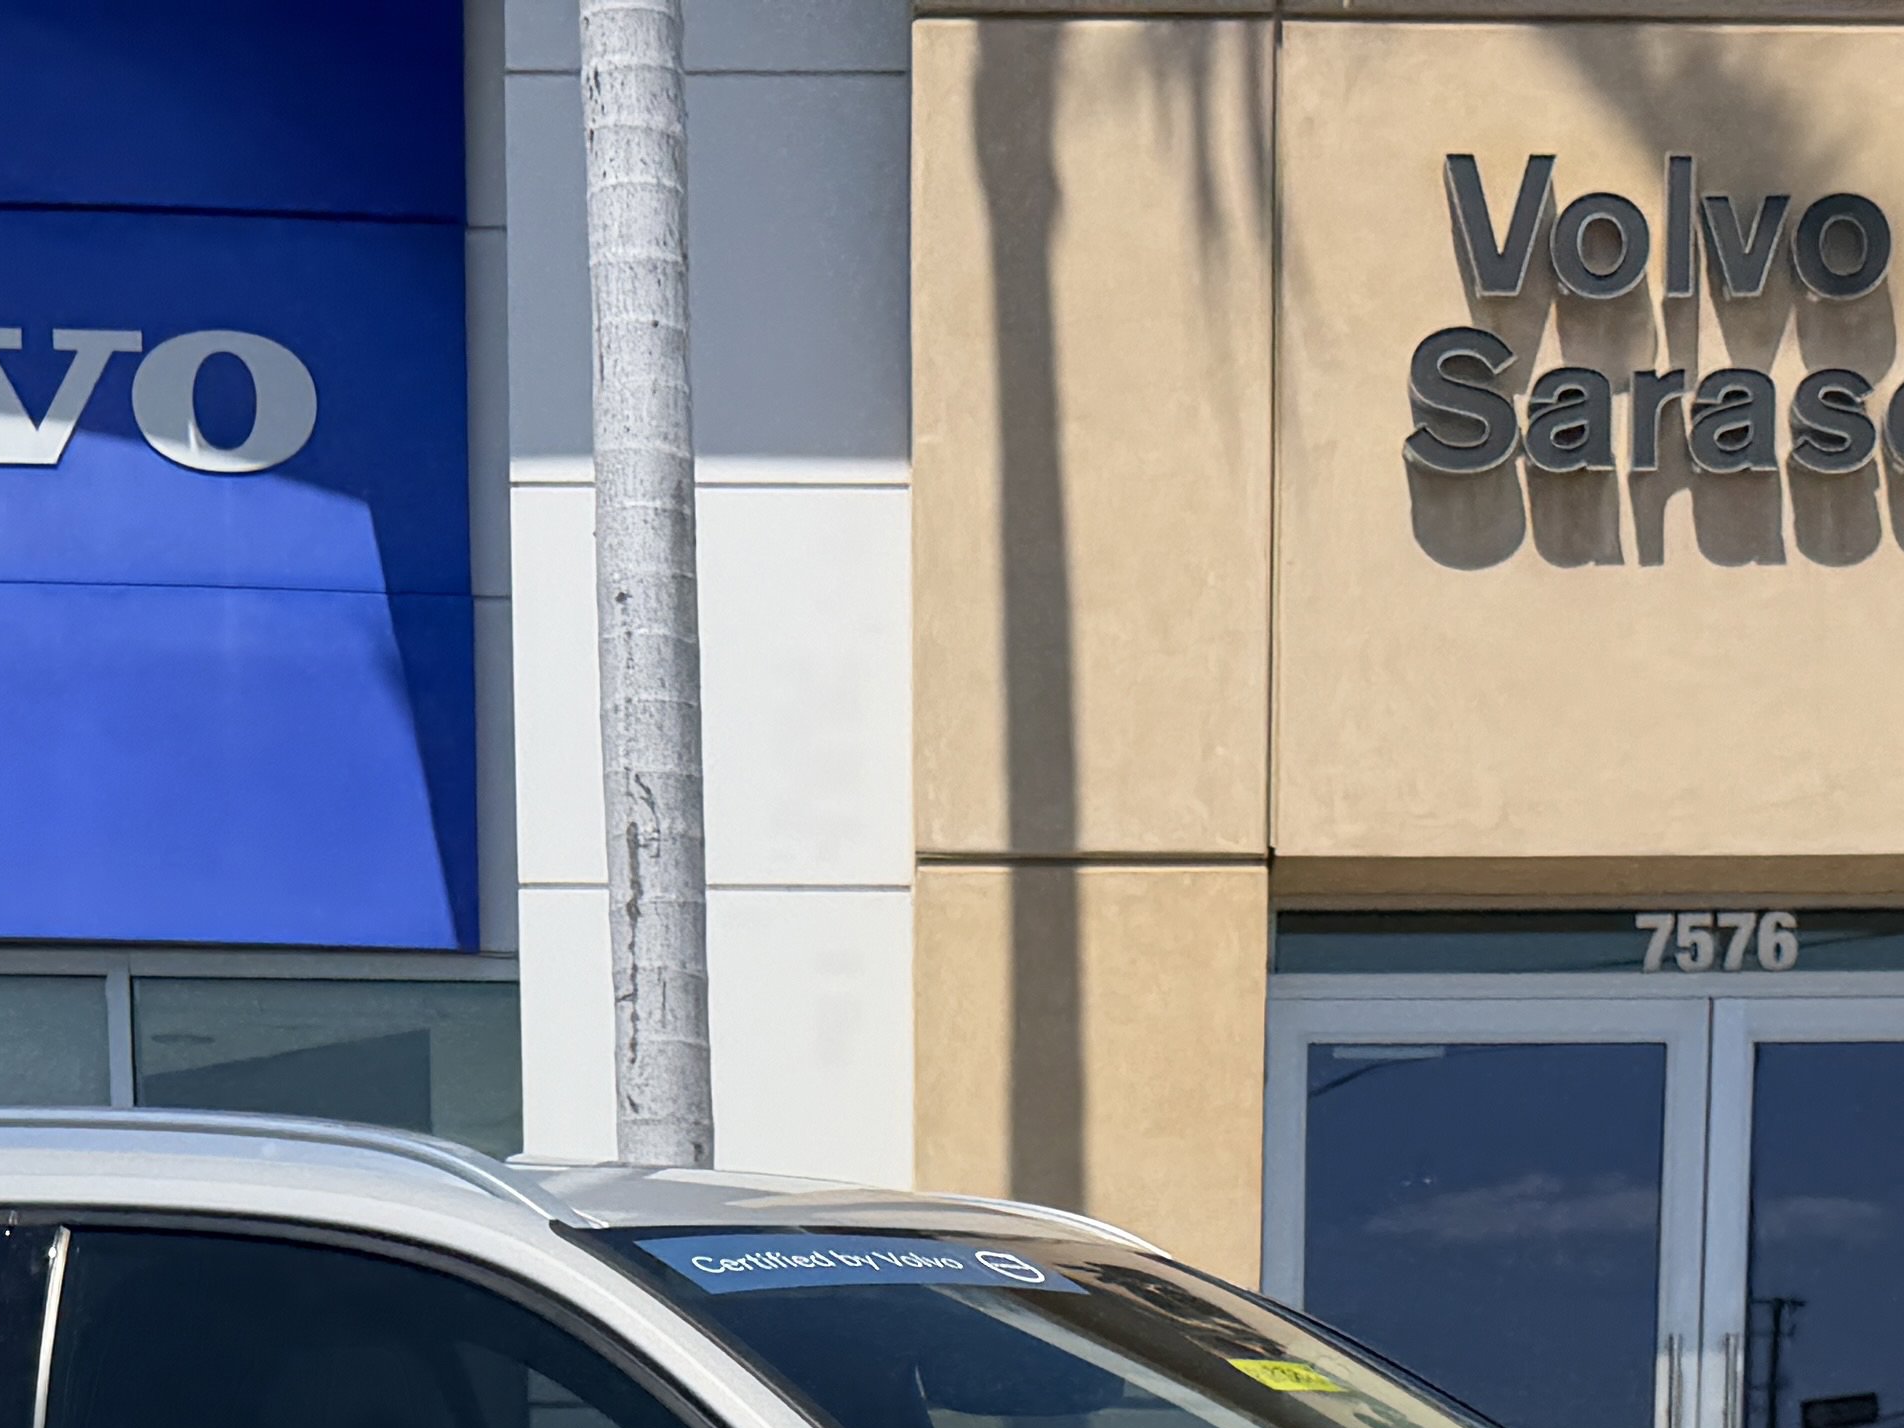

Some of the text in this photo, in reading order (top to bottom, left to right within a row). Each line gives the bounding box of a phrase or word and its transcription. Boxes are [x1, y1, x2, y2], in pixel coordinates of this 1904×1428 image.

[1443, 153, 1892, 300] Volvo
[1636, 911, 1799, 971] 7576
[691, 1250, 830, 1275] Certified
[829, 1250, 880, 1271] by
[879, 1251, 964, 1270] Volvo
